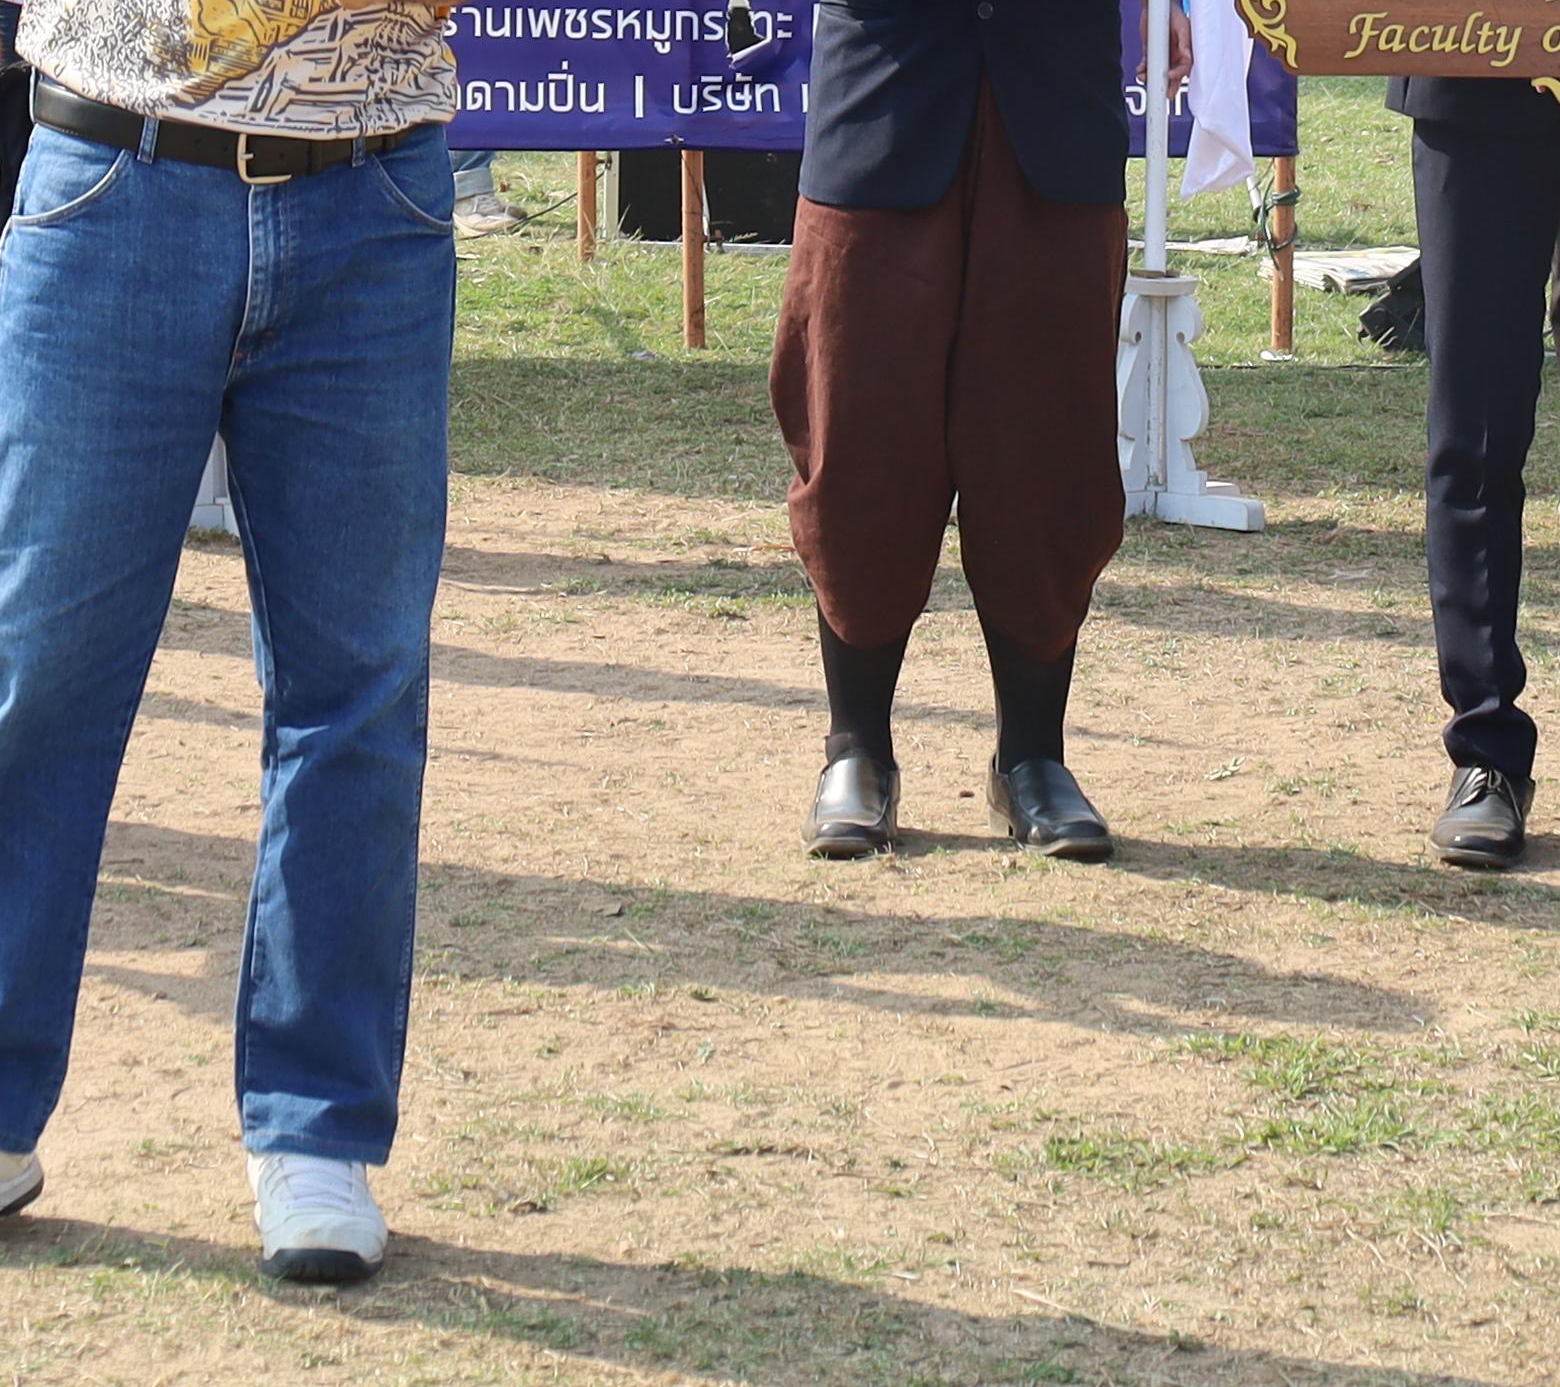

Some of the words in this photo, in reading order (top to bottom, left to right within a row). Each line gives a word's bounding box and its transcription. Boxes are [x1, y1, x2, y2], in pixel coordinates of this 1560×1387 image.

[1343, 10, 1525, 69] Faculty
[673, 72, 781, 114] บริษัท
